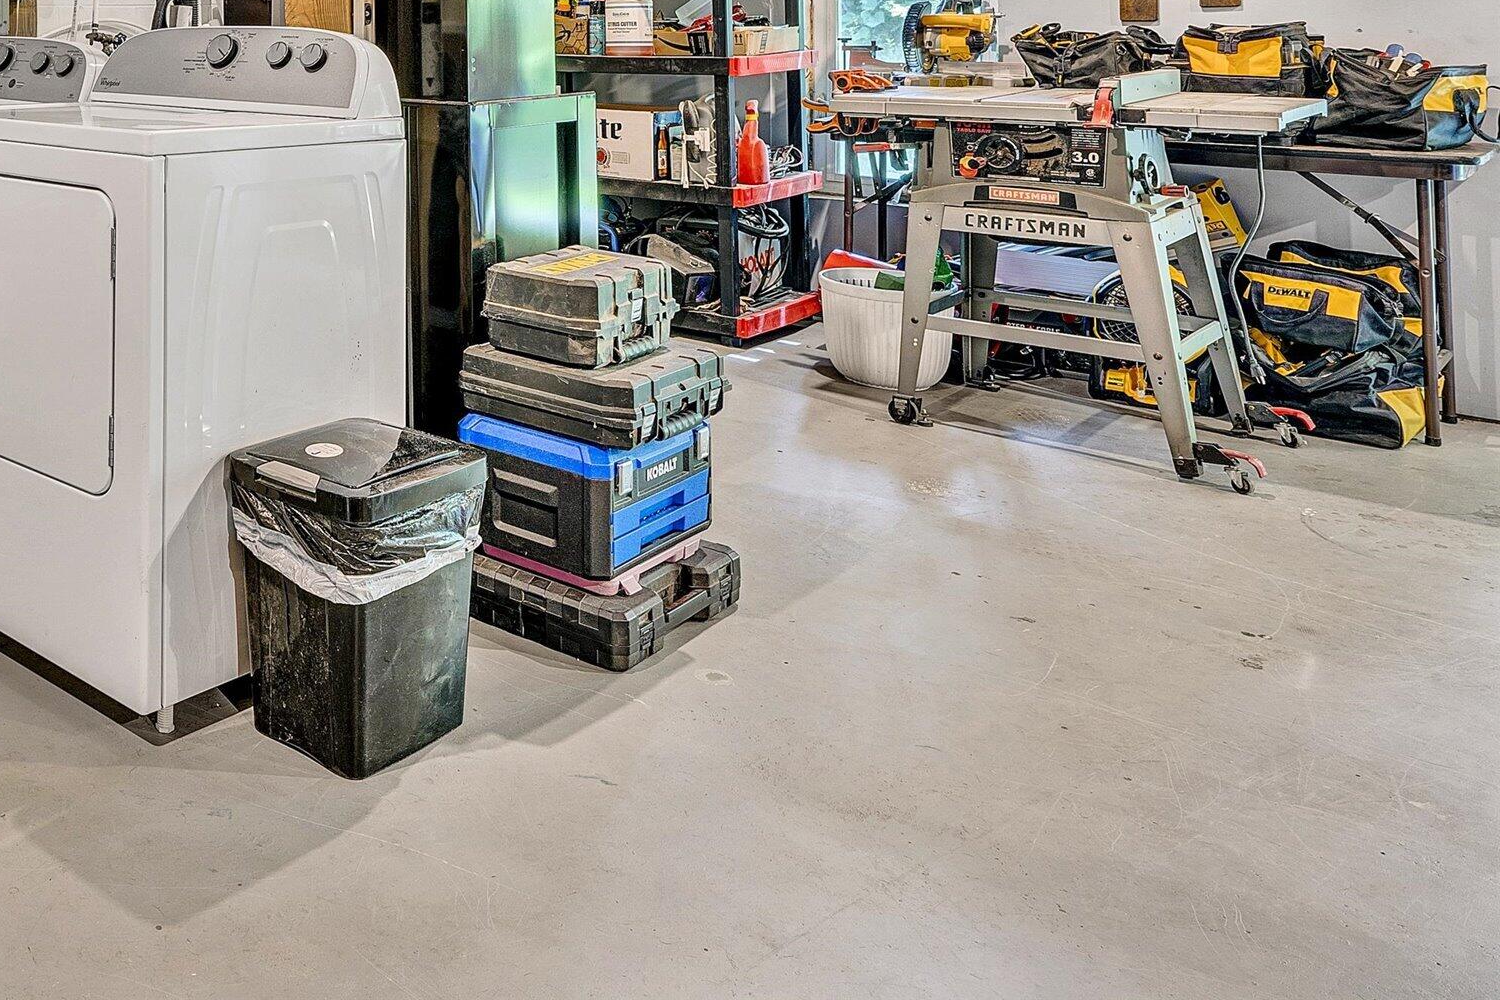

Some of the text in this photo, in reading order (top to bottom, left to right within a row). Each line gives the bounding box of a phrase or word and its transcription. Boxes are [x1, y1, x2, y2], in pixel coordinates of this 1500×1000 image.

[597, 118, 623, 140] te
[1072, 151, 1099, 164] 3.0
[993, 189, 1056, 202] CRAFTSMAN
[965, 213, 1086, 239] CRAFTSMAN
[1268, 286, 1311, 298] DEWALT
[646, 456, 678, 482] KOBALT
